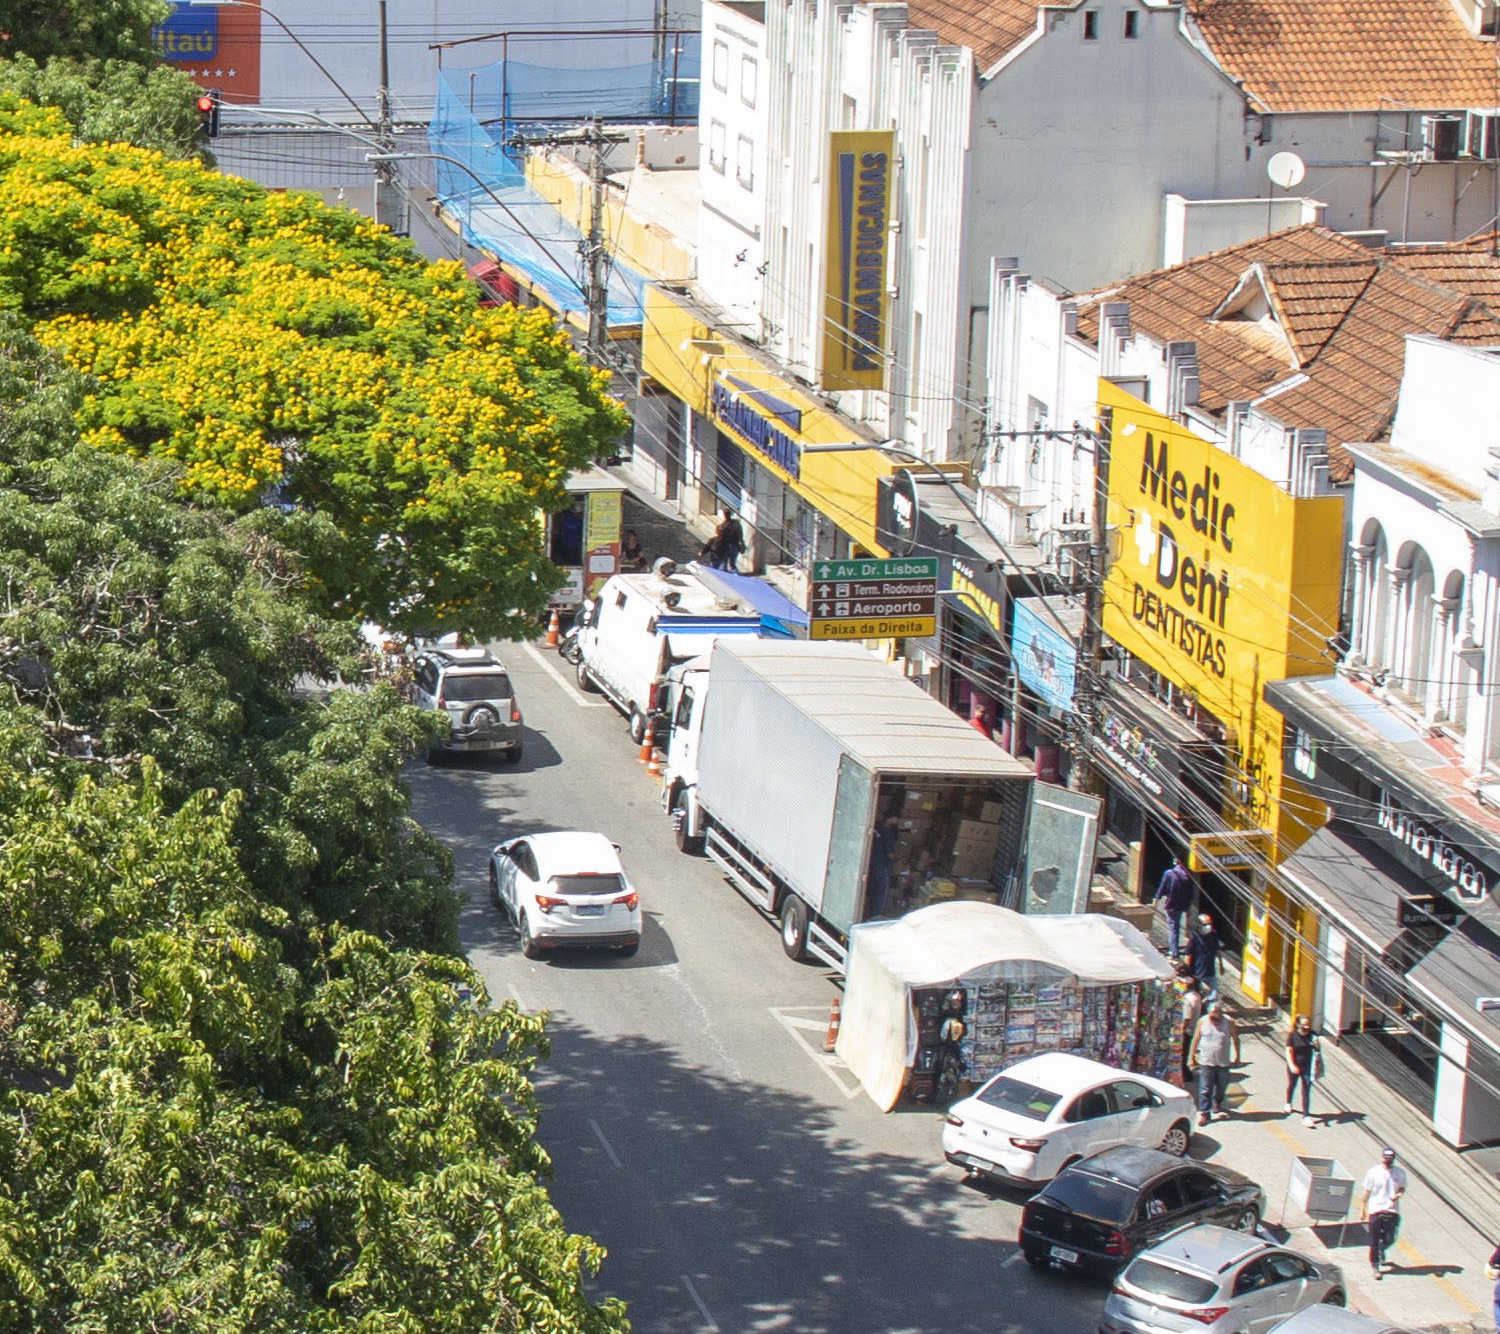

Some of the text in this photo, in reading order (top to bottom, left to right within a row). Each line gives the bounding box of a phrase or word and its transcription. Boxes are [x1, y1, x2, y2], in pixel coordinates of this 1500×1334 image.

[157, 28, 213, 52] Itaú
[852, 151, 888, 371] PERNAMBUCANAS
[1139, 431, 1235, 553] Medic
[837, 563, 930, 577] Av. Dr. Lisboa
[1156, 521, 1230, 629] Dent
[854, 582, 934, 596] Term. Rodoviário
[853, 601, 921, 616] Aeroporto
[823, 621, 923, 635] Faixa da Direita
[1133, 582, 1226, 679] DENTISTAS
